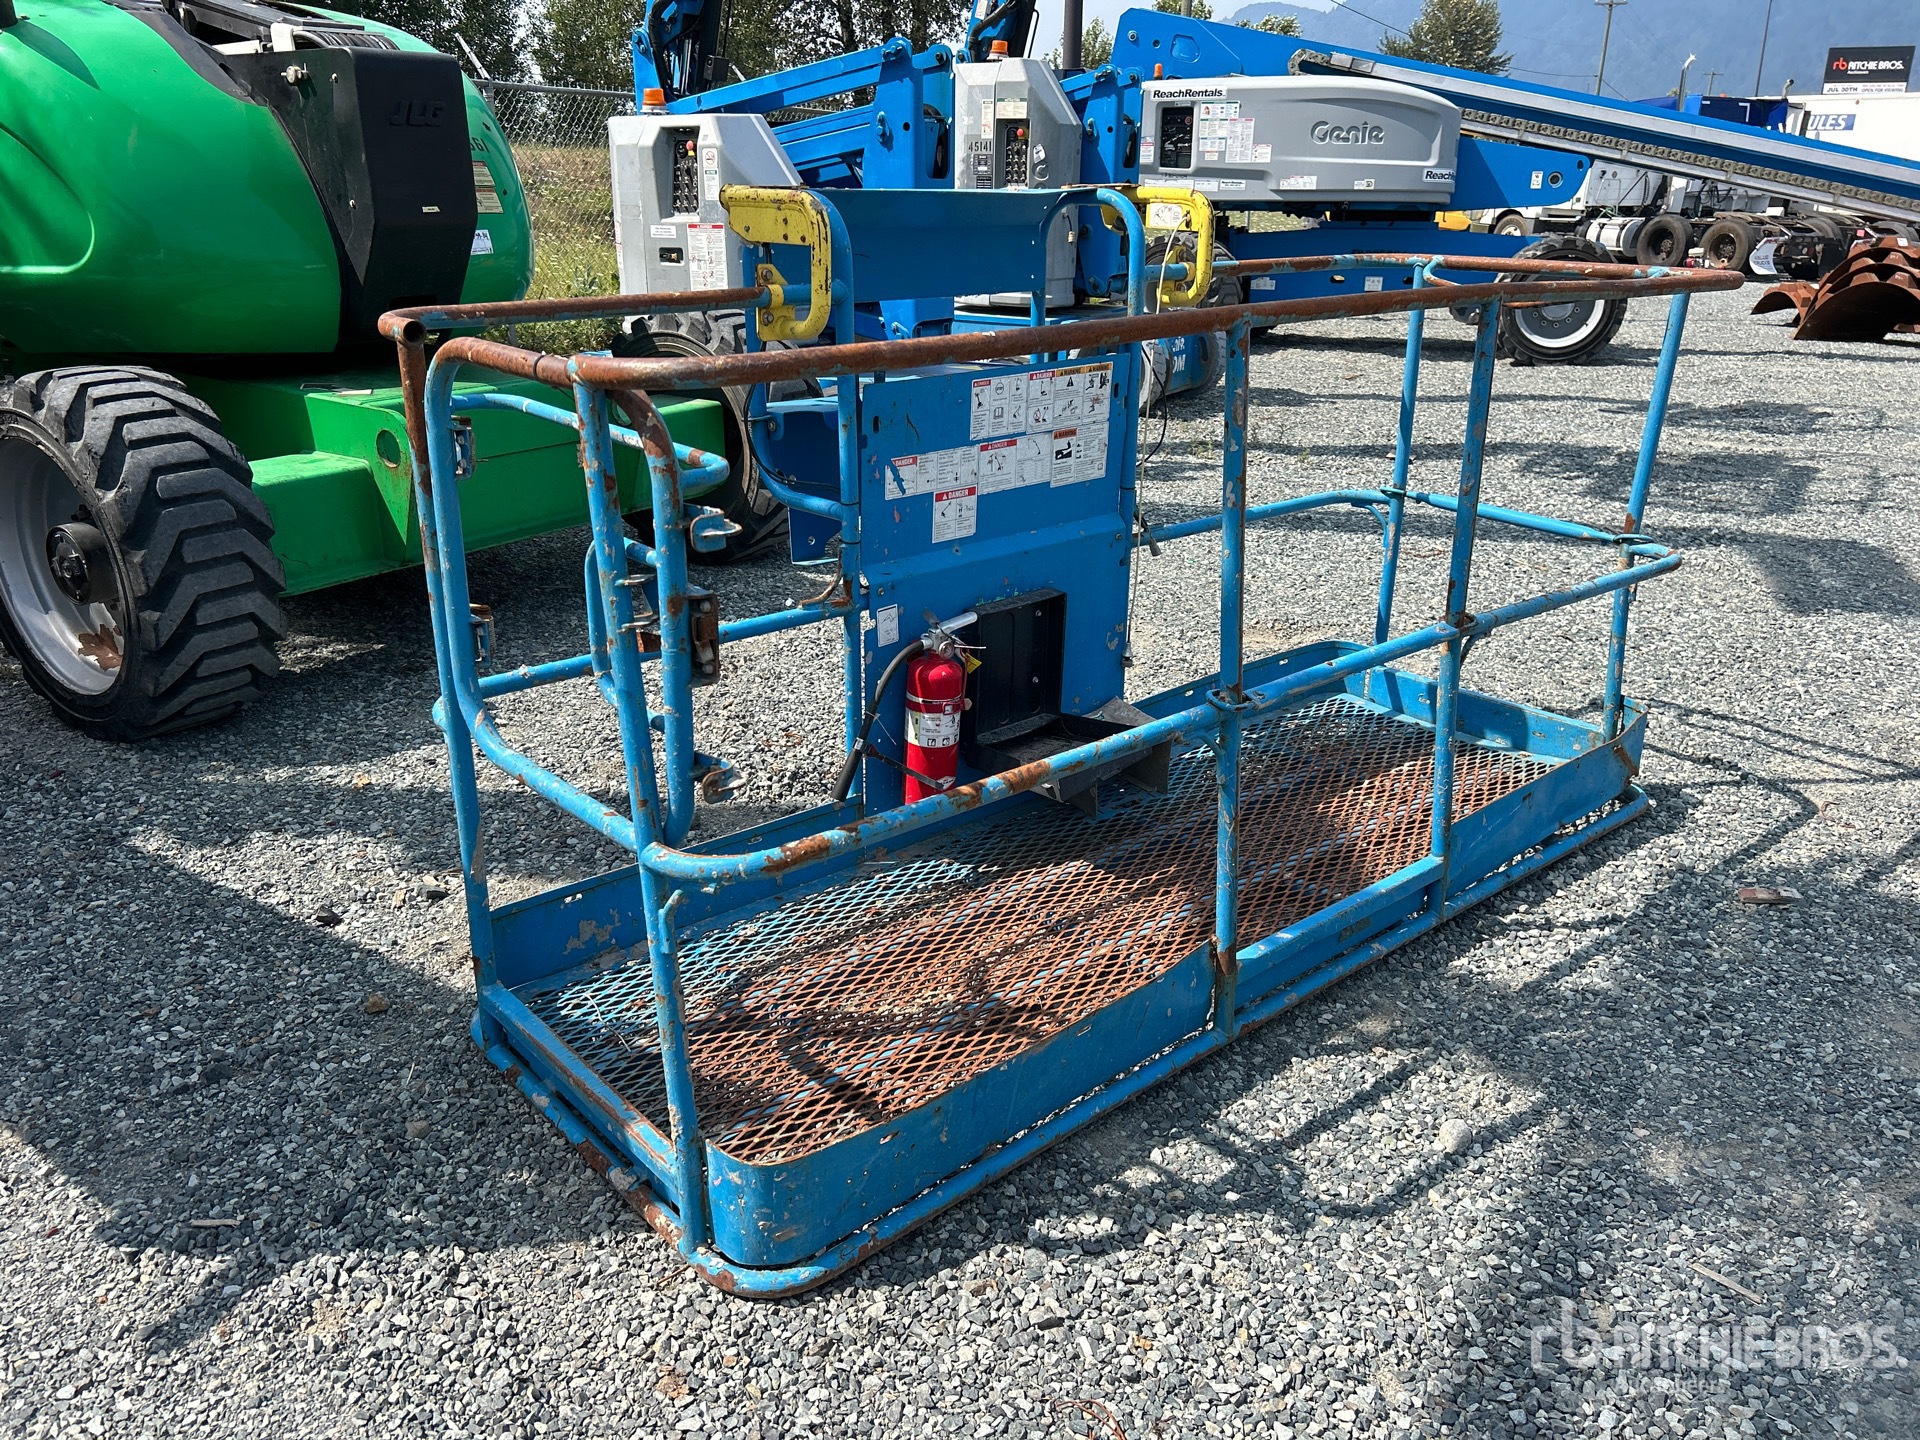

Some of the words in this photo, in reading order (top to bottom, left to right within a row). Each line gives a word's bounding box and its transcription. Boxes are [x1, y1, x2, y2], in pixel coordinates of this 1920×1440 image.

[1848, 60, 1878, 70] RITCHIE
[390, 99, 446, 127] JLG
[1310, 120, 1385, 144] Genie
[968, 140, 992, 152] 45141
[948, 489, 969, 499] DANGER
